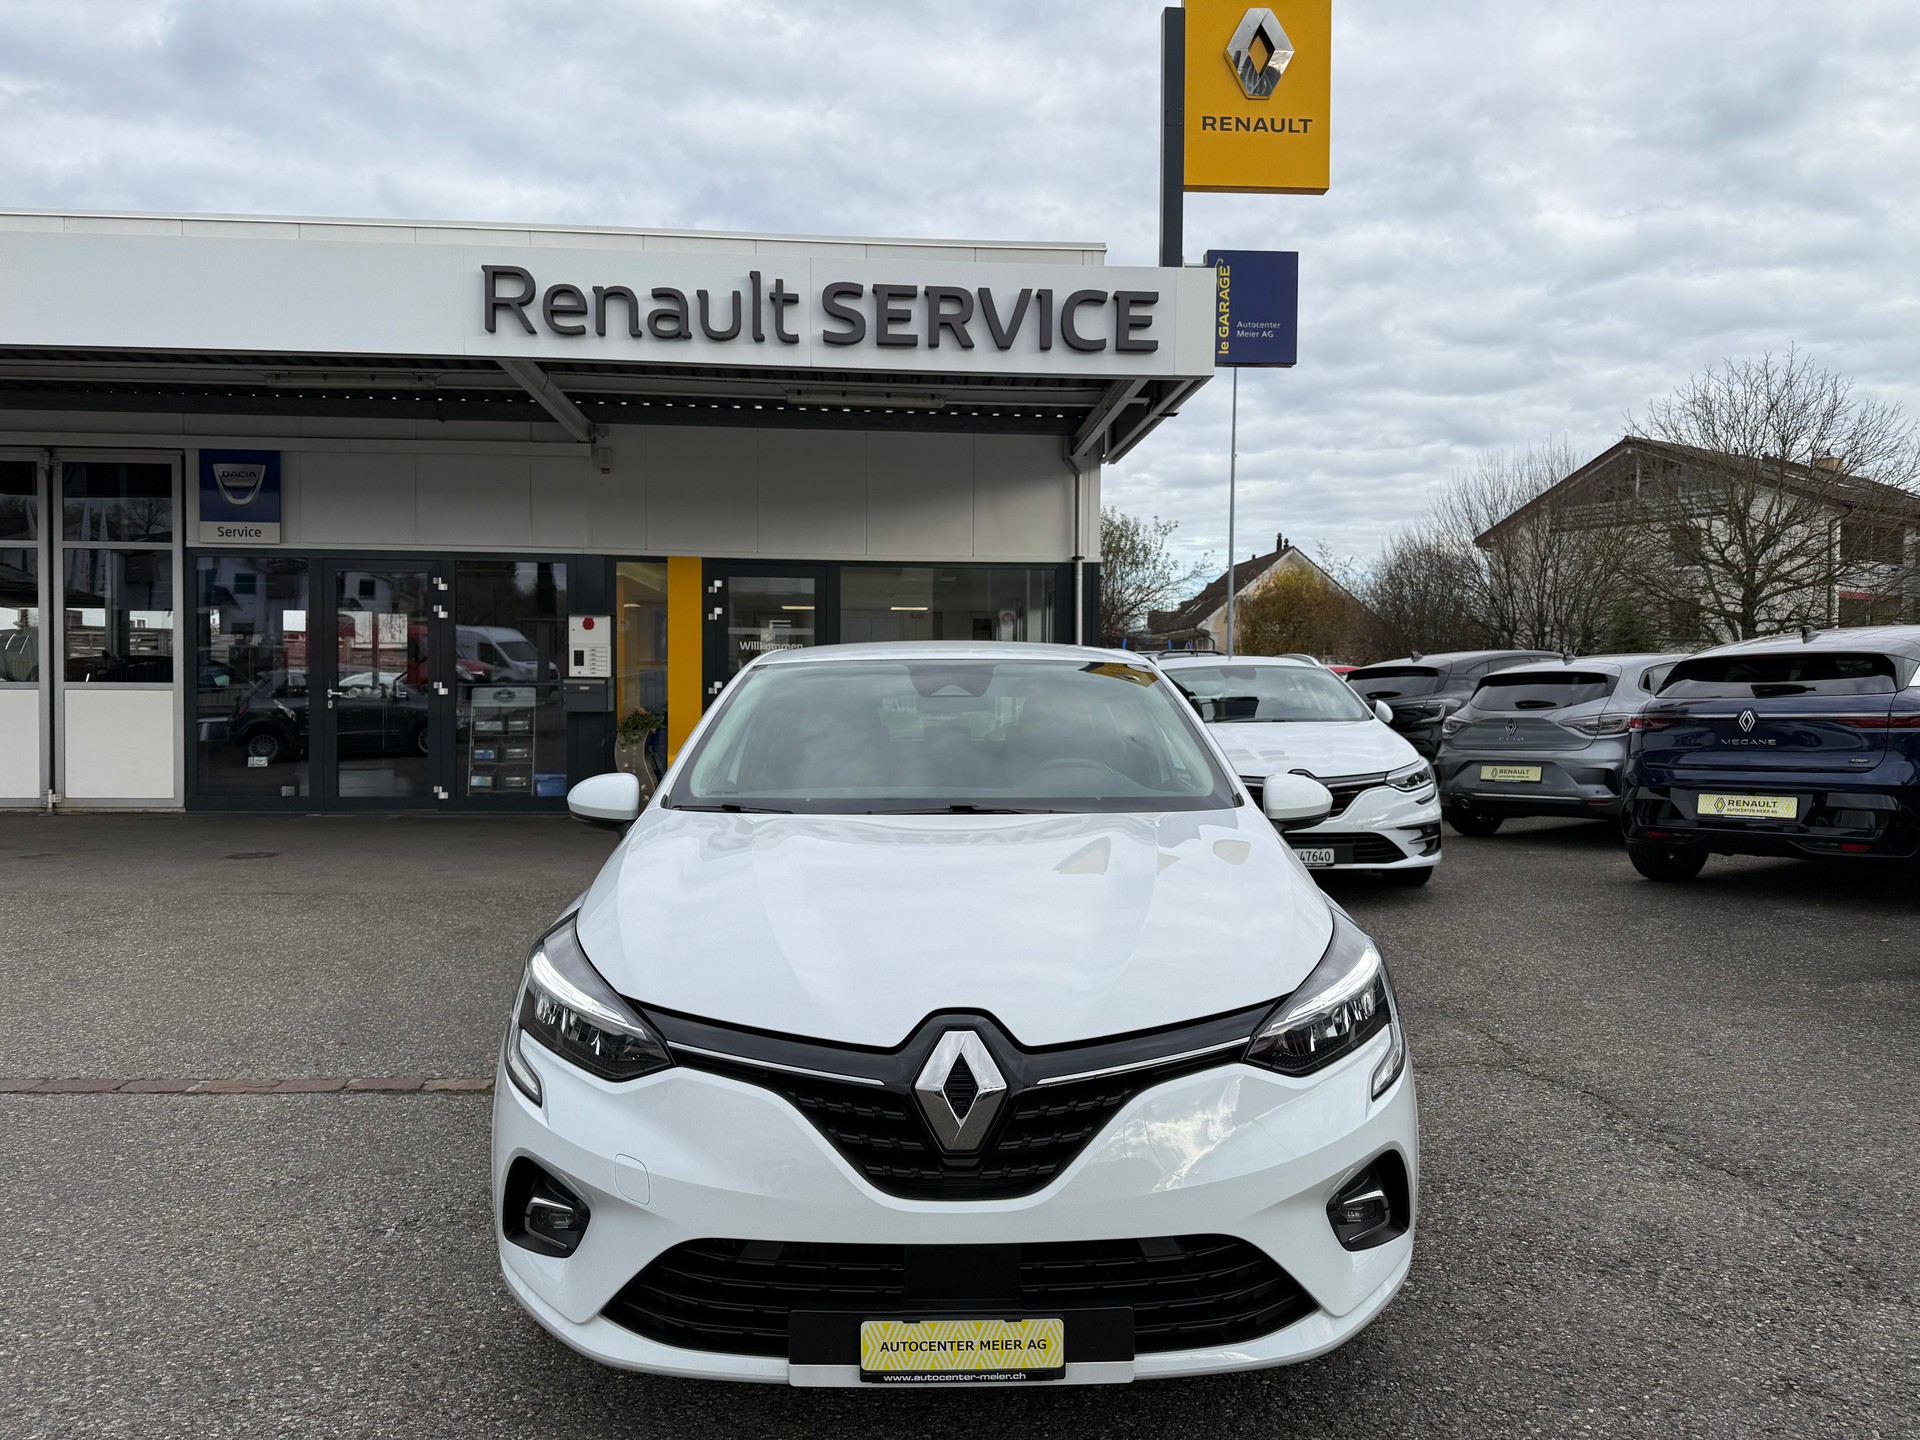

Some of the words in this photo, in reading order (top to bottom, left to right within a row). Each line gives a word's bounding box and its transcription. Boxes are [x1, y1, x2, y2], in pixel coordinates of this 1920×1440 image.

[1202, 115, 1313, 134] RENAULT
[1218, 265, 1231, 338] GARAGE
[481, 264, 800, 345] Renault
[821, 281, 1160, 354] SERVICE
[1236, 321, 1281, 329] Autocenter
[1236, 330, 1259, 338] Meier
[1261, 330, 1274, 338] AG
[1218, 341, 1229, 355] le
[222, 470, 257, 478] DACIA
[217, 526, 262, 537] Service
[1721, 738, 1776, 746] MEGANE
[1728, 799, 1778, 808] RENAULT
[1299, 850, 1331, 862] 47640
[880, 1340, 975, 1352] AUTOCENTER
[979, 1339, 1023, 1351] MEIER
[1027, 1339, 1047, 1350] AG
[883, 1372, 1027, 1382] www.autocenter-meier.ch
